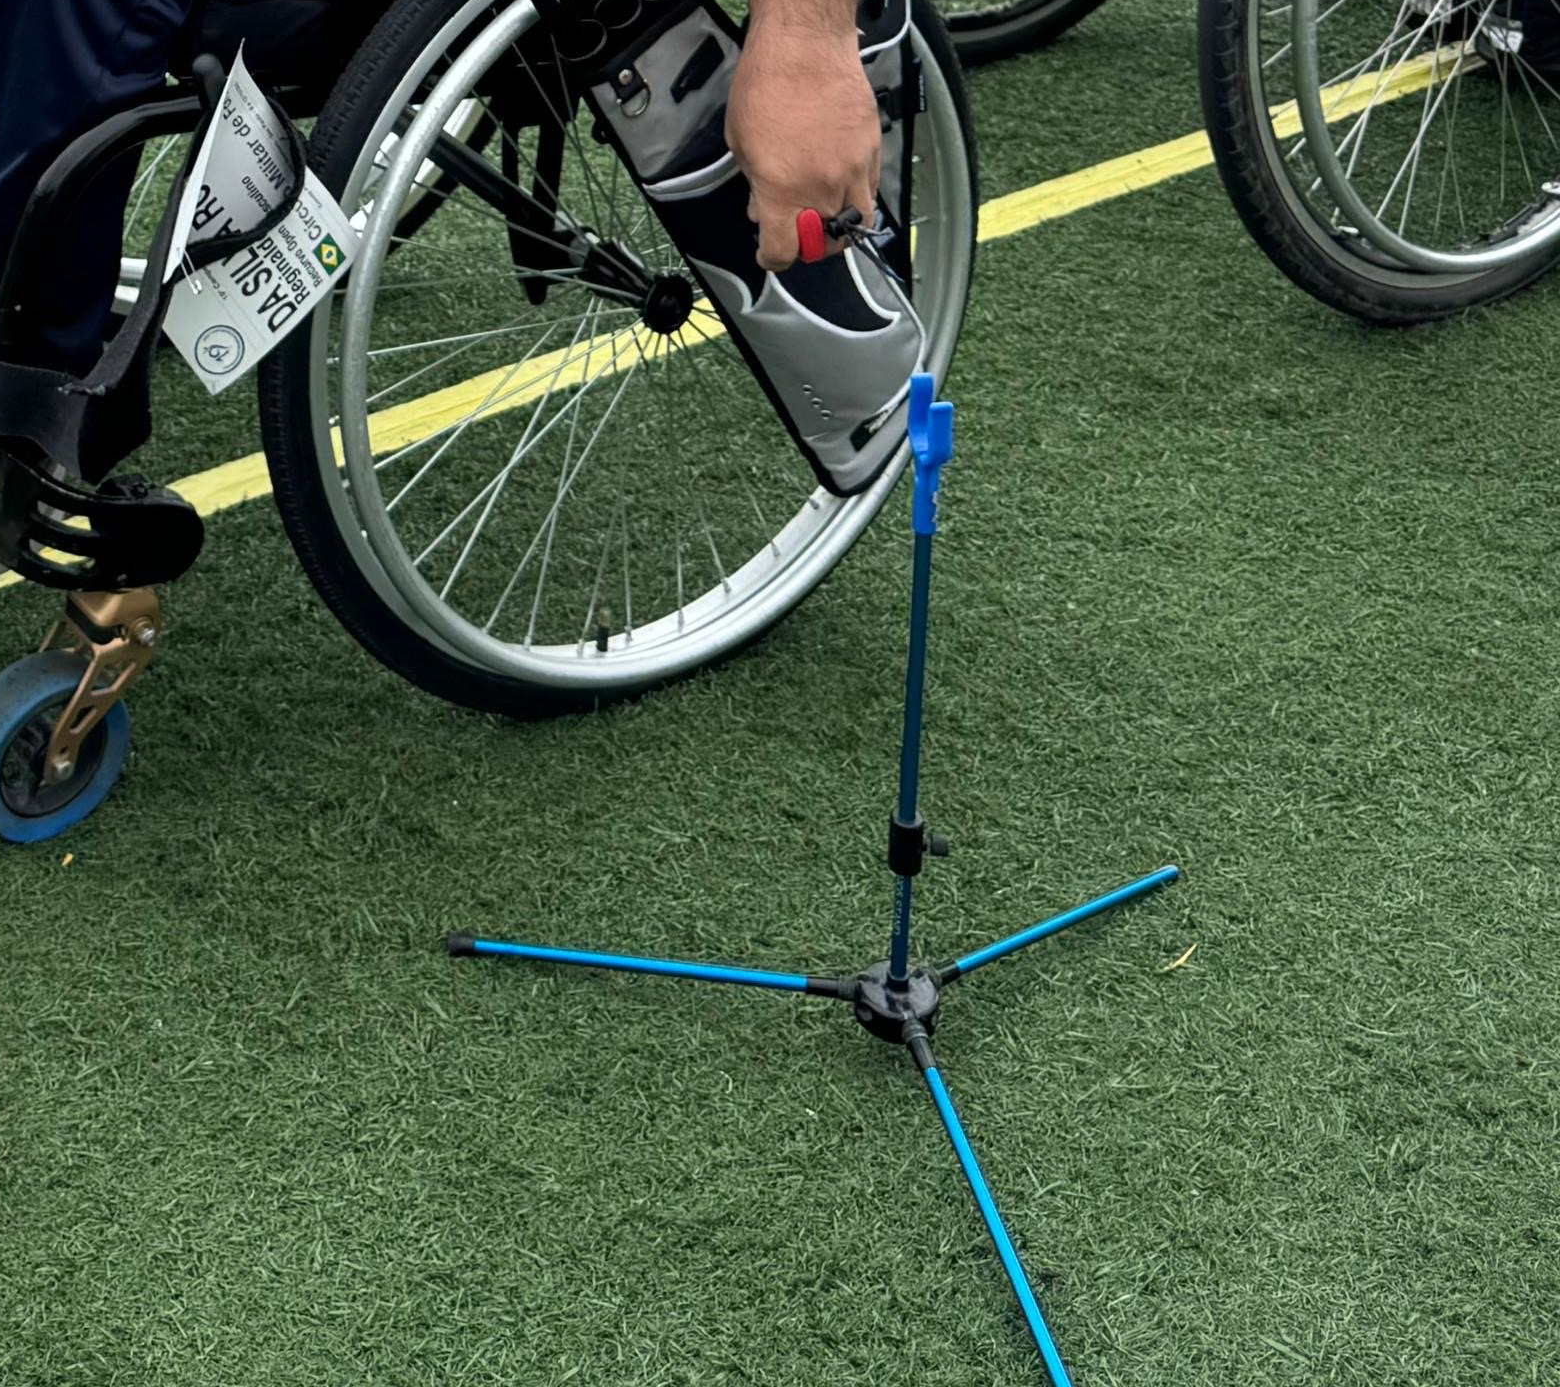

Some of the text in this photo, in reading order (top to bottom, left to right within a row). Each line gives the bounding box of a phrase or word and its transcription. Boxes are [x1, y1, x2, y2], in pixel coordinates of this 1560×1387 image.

[231, 115, 252, 139] de
[245, 138, 287, 189] Militar
[277, 224, 298, 249] Open
[261, 234, 310, 304] Reginald
[293, 247, 323, 287] Recurvo
[256, 288, 297, 333] DA
